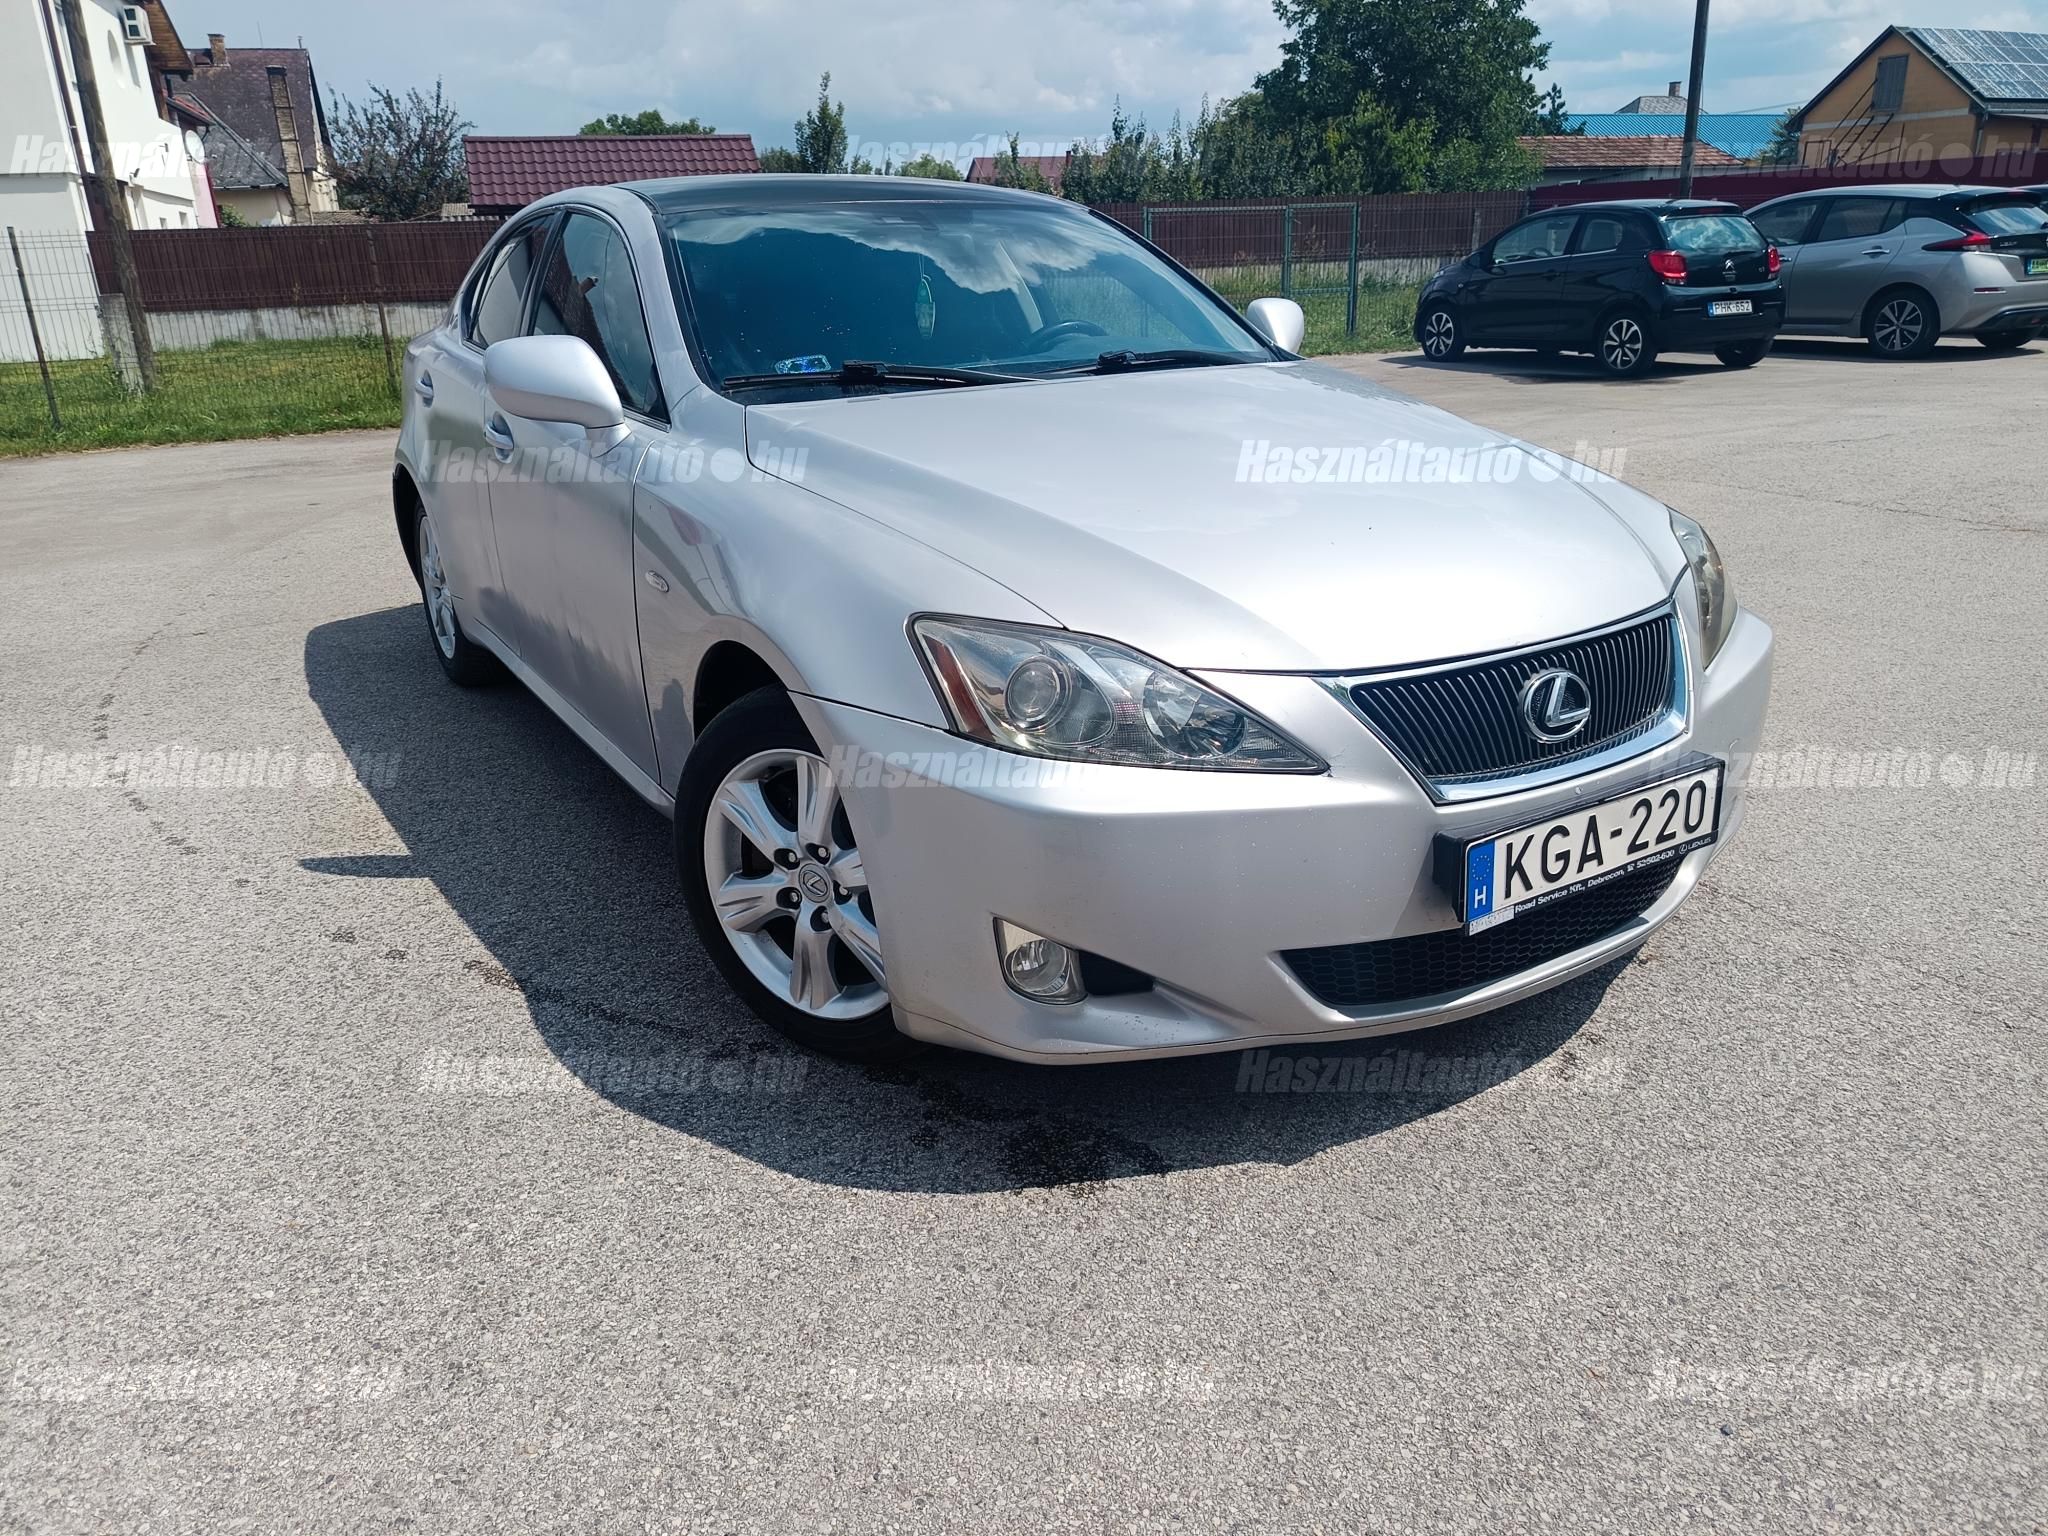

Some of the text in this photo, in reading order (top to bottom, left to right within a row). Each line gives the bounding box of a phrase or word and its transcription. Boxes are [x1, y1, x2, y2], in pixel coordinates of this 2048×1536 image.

[1503, 779, 1707, 899] KGA-220
[1473, 885, 1487, 909] H
[1514, 898, 1536, 913] Road
[1537, 888, 1568, 905] Service
